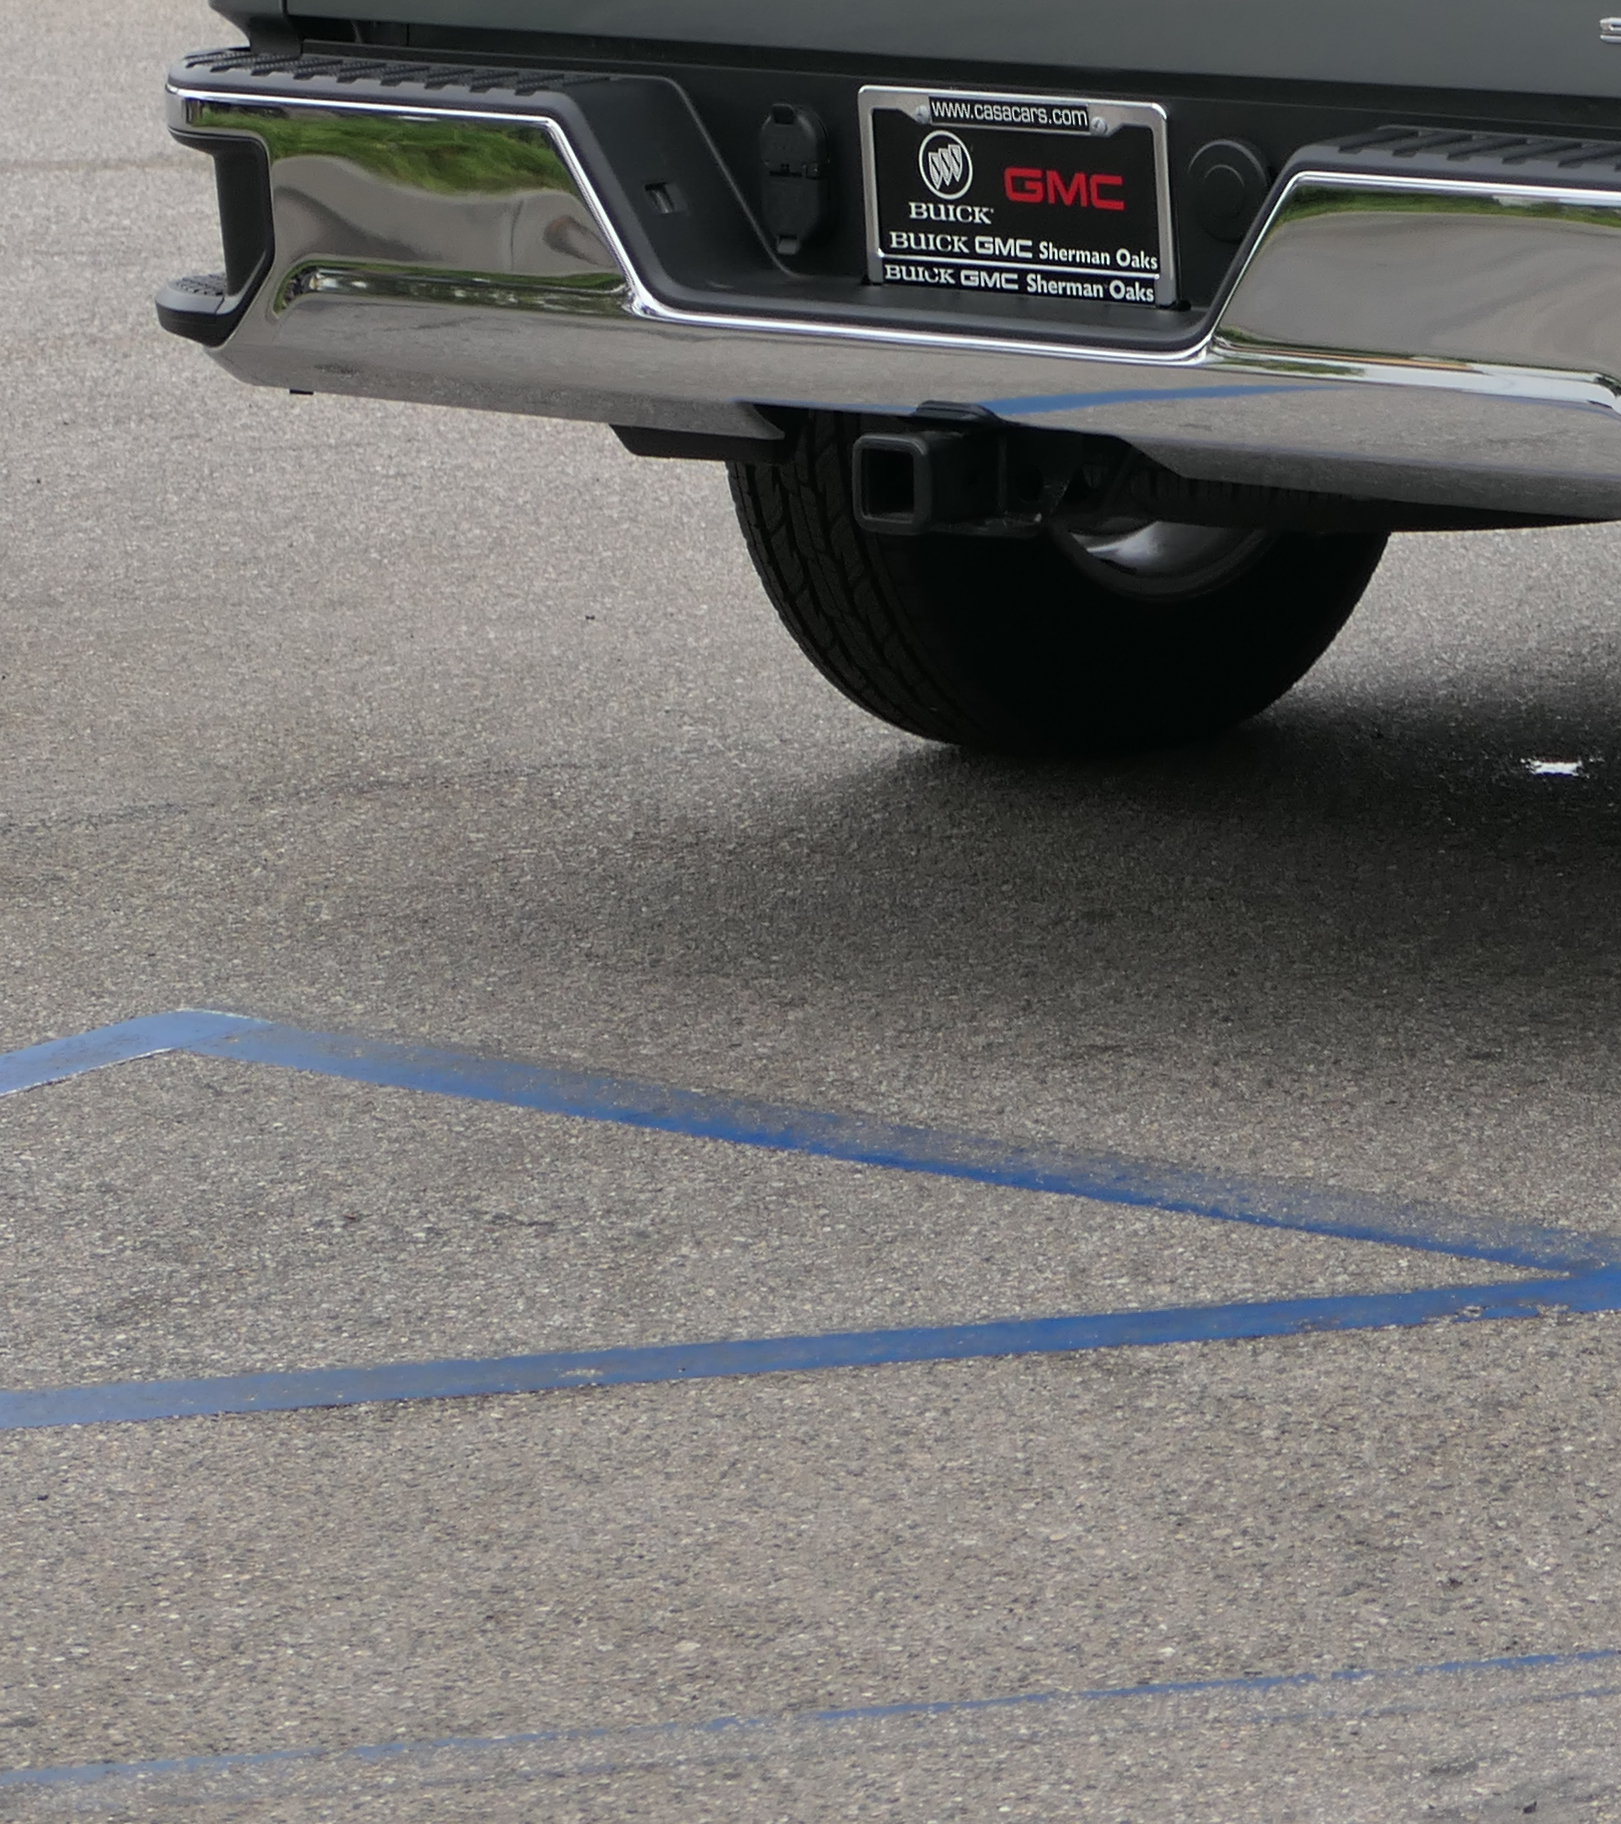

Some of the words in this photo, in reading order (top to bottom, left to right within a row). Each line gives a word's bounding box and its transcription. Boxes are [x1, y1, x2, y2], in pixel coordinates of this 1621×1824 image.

[930, 100, 1089, 128] www.casacars.com
[1004, 167, 1125, 212] GMC
[908, 202, 994, 225] BUICK
[889, 232, 970, 253] BUICK
[974, 236, 1033, 258] GMC
[1038, 241, 1112, 267] Sherman
[1115, 248, 1159, 271] Oaks
[884, 265, 956, 286] BUICK
[960, 270, 1019, 291] GMC
[1026, 273, 1104, 299] Sherman
[1109, 280, 1155, 304] Oaks
